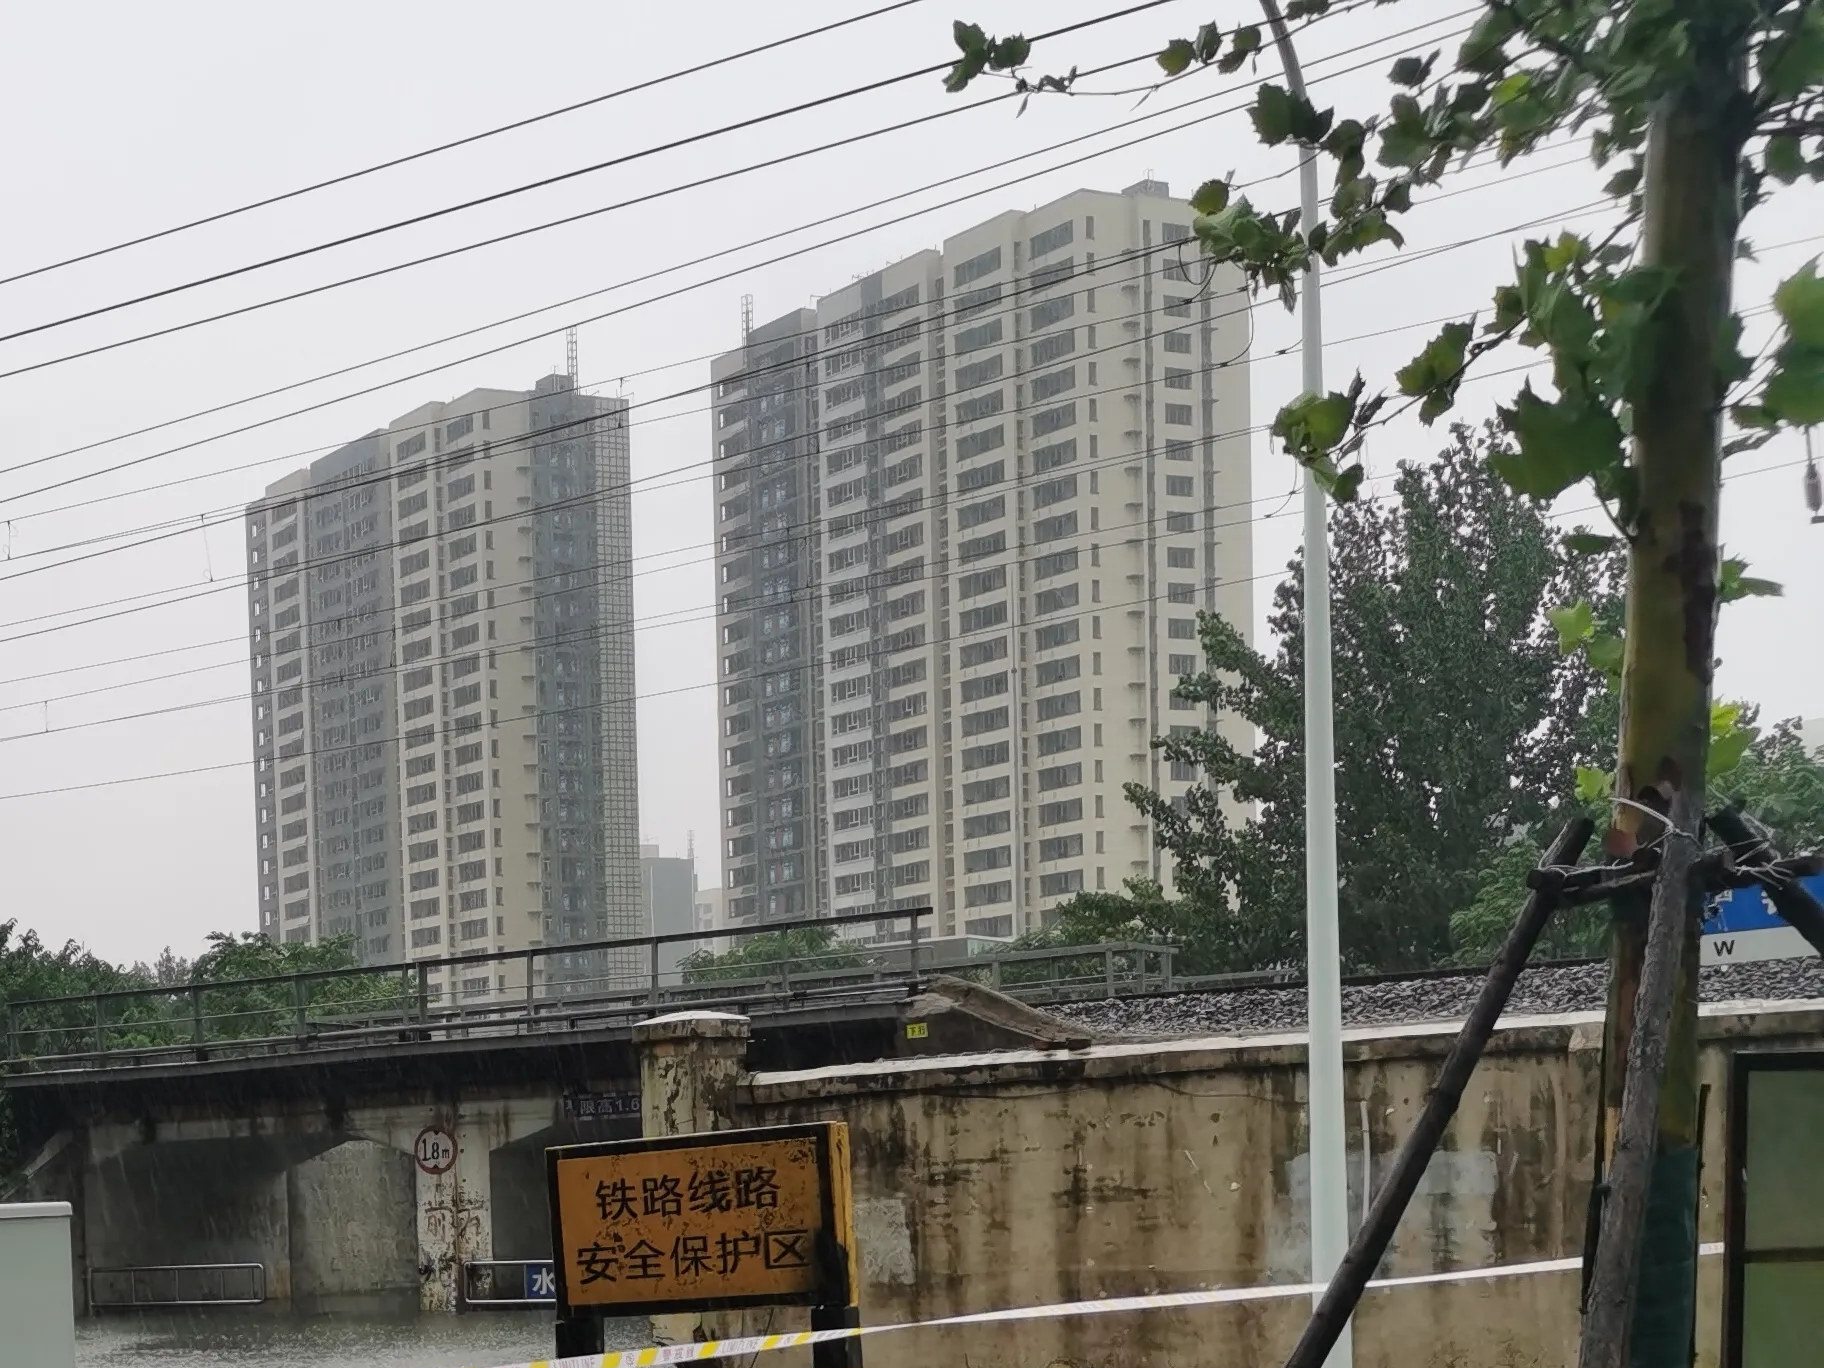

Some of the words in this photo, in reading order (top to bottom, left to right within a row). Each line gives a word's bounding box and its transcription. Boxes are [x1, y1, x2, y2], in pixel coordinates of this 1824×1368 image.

[1713, 939, 1735, 957] W
[595, 1168, 780, 1222] 铁路线路
[577, 1229, 810, 1285] 安全保护区
[720, 1336, 761, 1354] LIMITLINE
